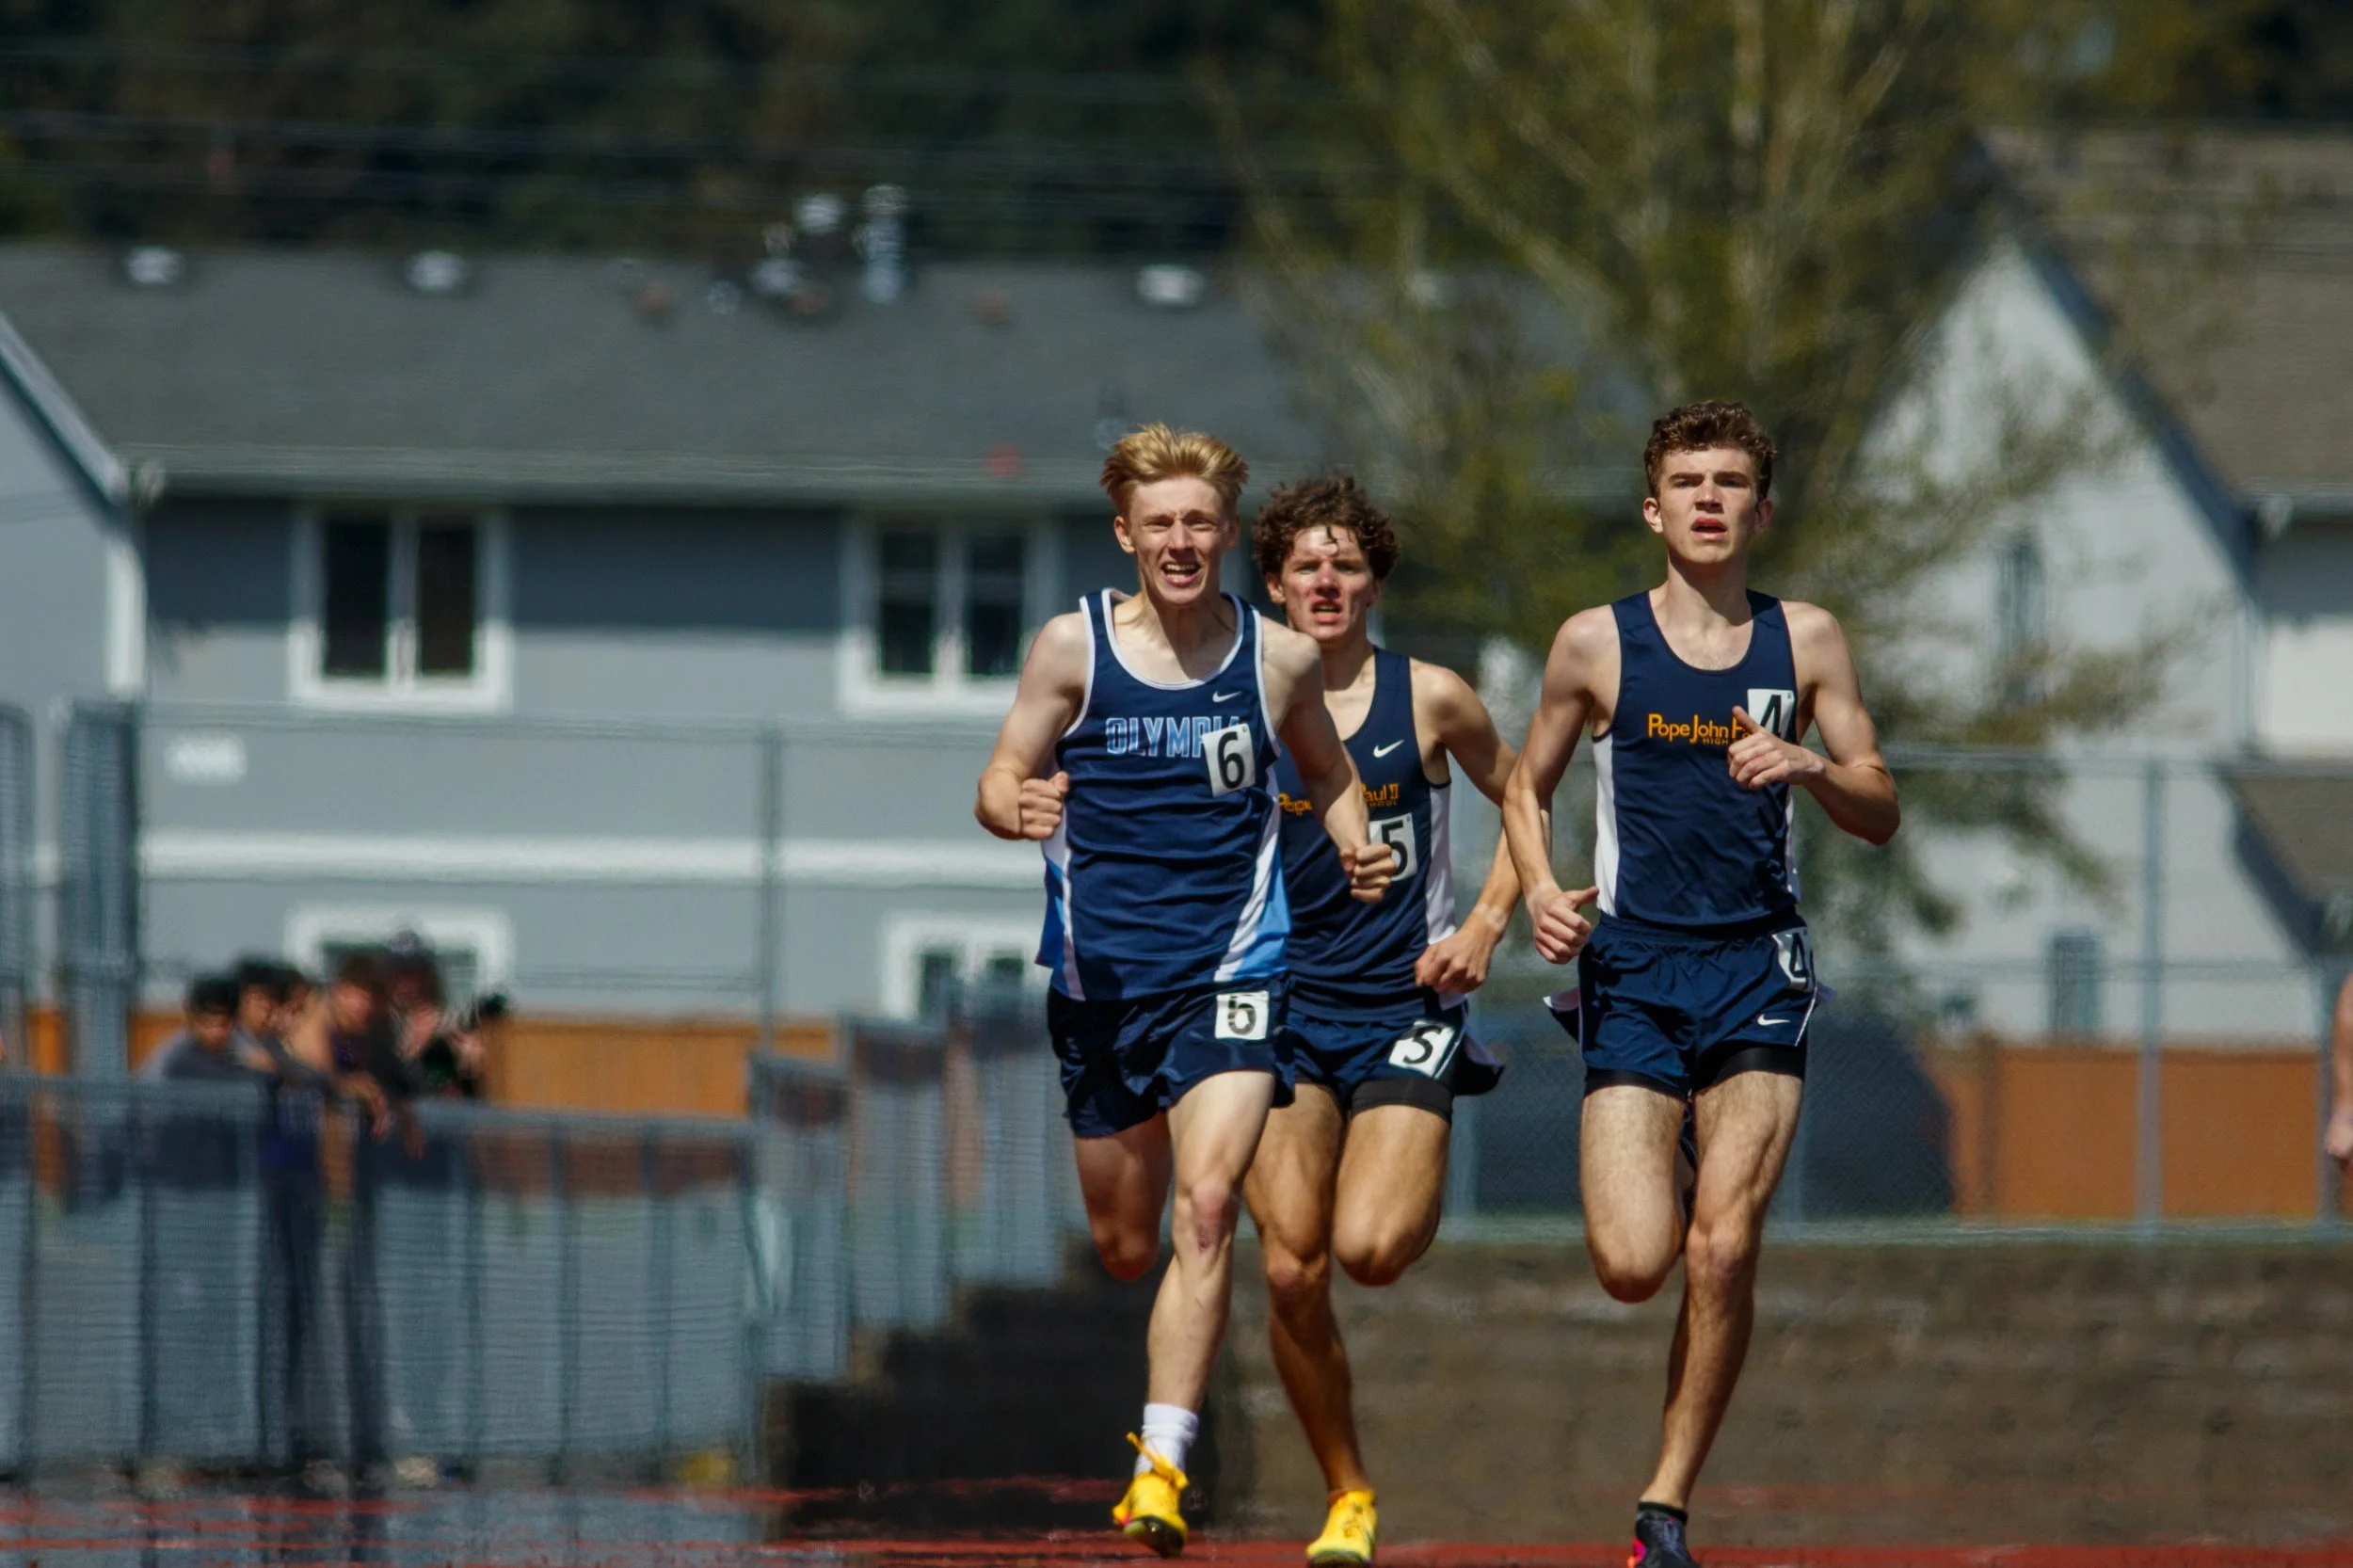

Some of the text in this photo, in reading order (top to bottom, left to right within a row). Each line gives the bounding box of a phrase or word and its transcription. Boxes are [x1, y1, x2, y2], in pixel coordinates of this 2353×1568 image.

[1105, 715, 1240, 758] OLYMP
[1648, 712, 1690, 743] Pope
[1689, 714, 1729, 744] John
[1760, 694, 1782, 737] 4
[1218, 731, 1245, 790] 6
[1382, 820, 1408, 876] 5
[1789, 933, 1809, 991] 4
[1402, 1025, 1443, 1064] 5
